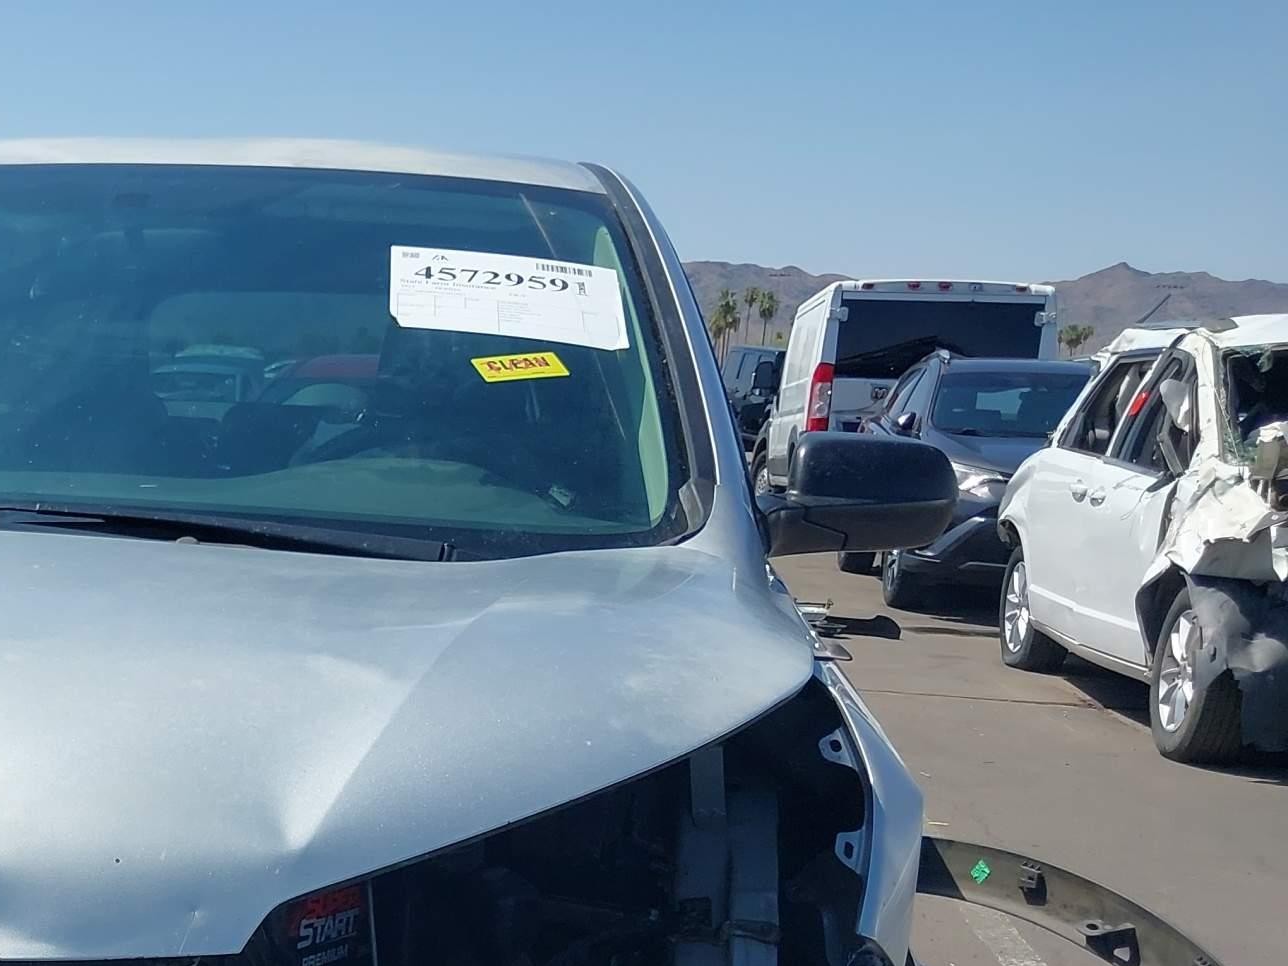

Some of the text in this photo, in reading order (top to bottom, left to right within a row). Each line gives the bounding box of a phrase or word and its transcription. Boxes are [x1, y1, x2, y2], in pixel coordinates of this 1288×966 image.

[414, 265, 589, 297] 45729591
[486, 356, 551, 373] CLEAN
[296, 906, 361, 950] START
